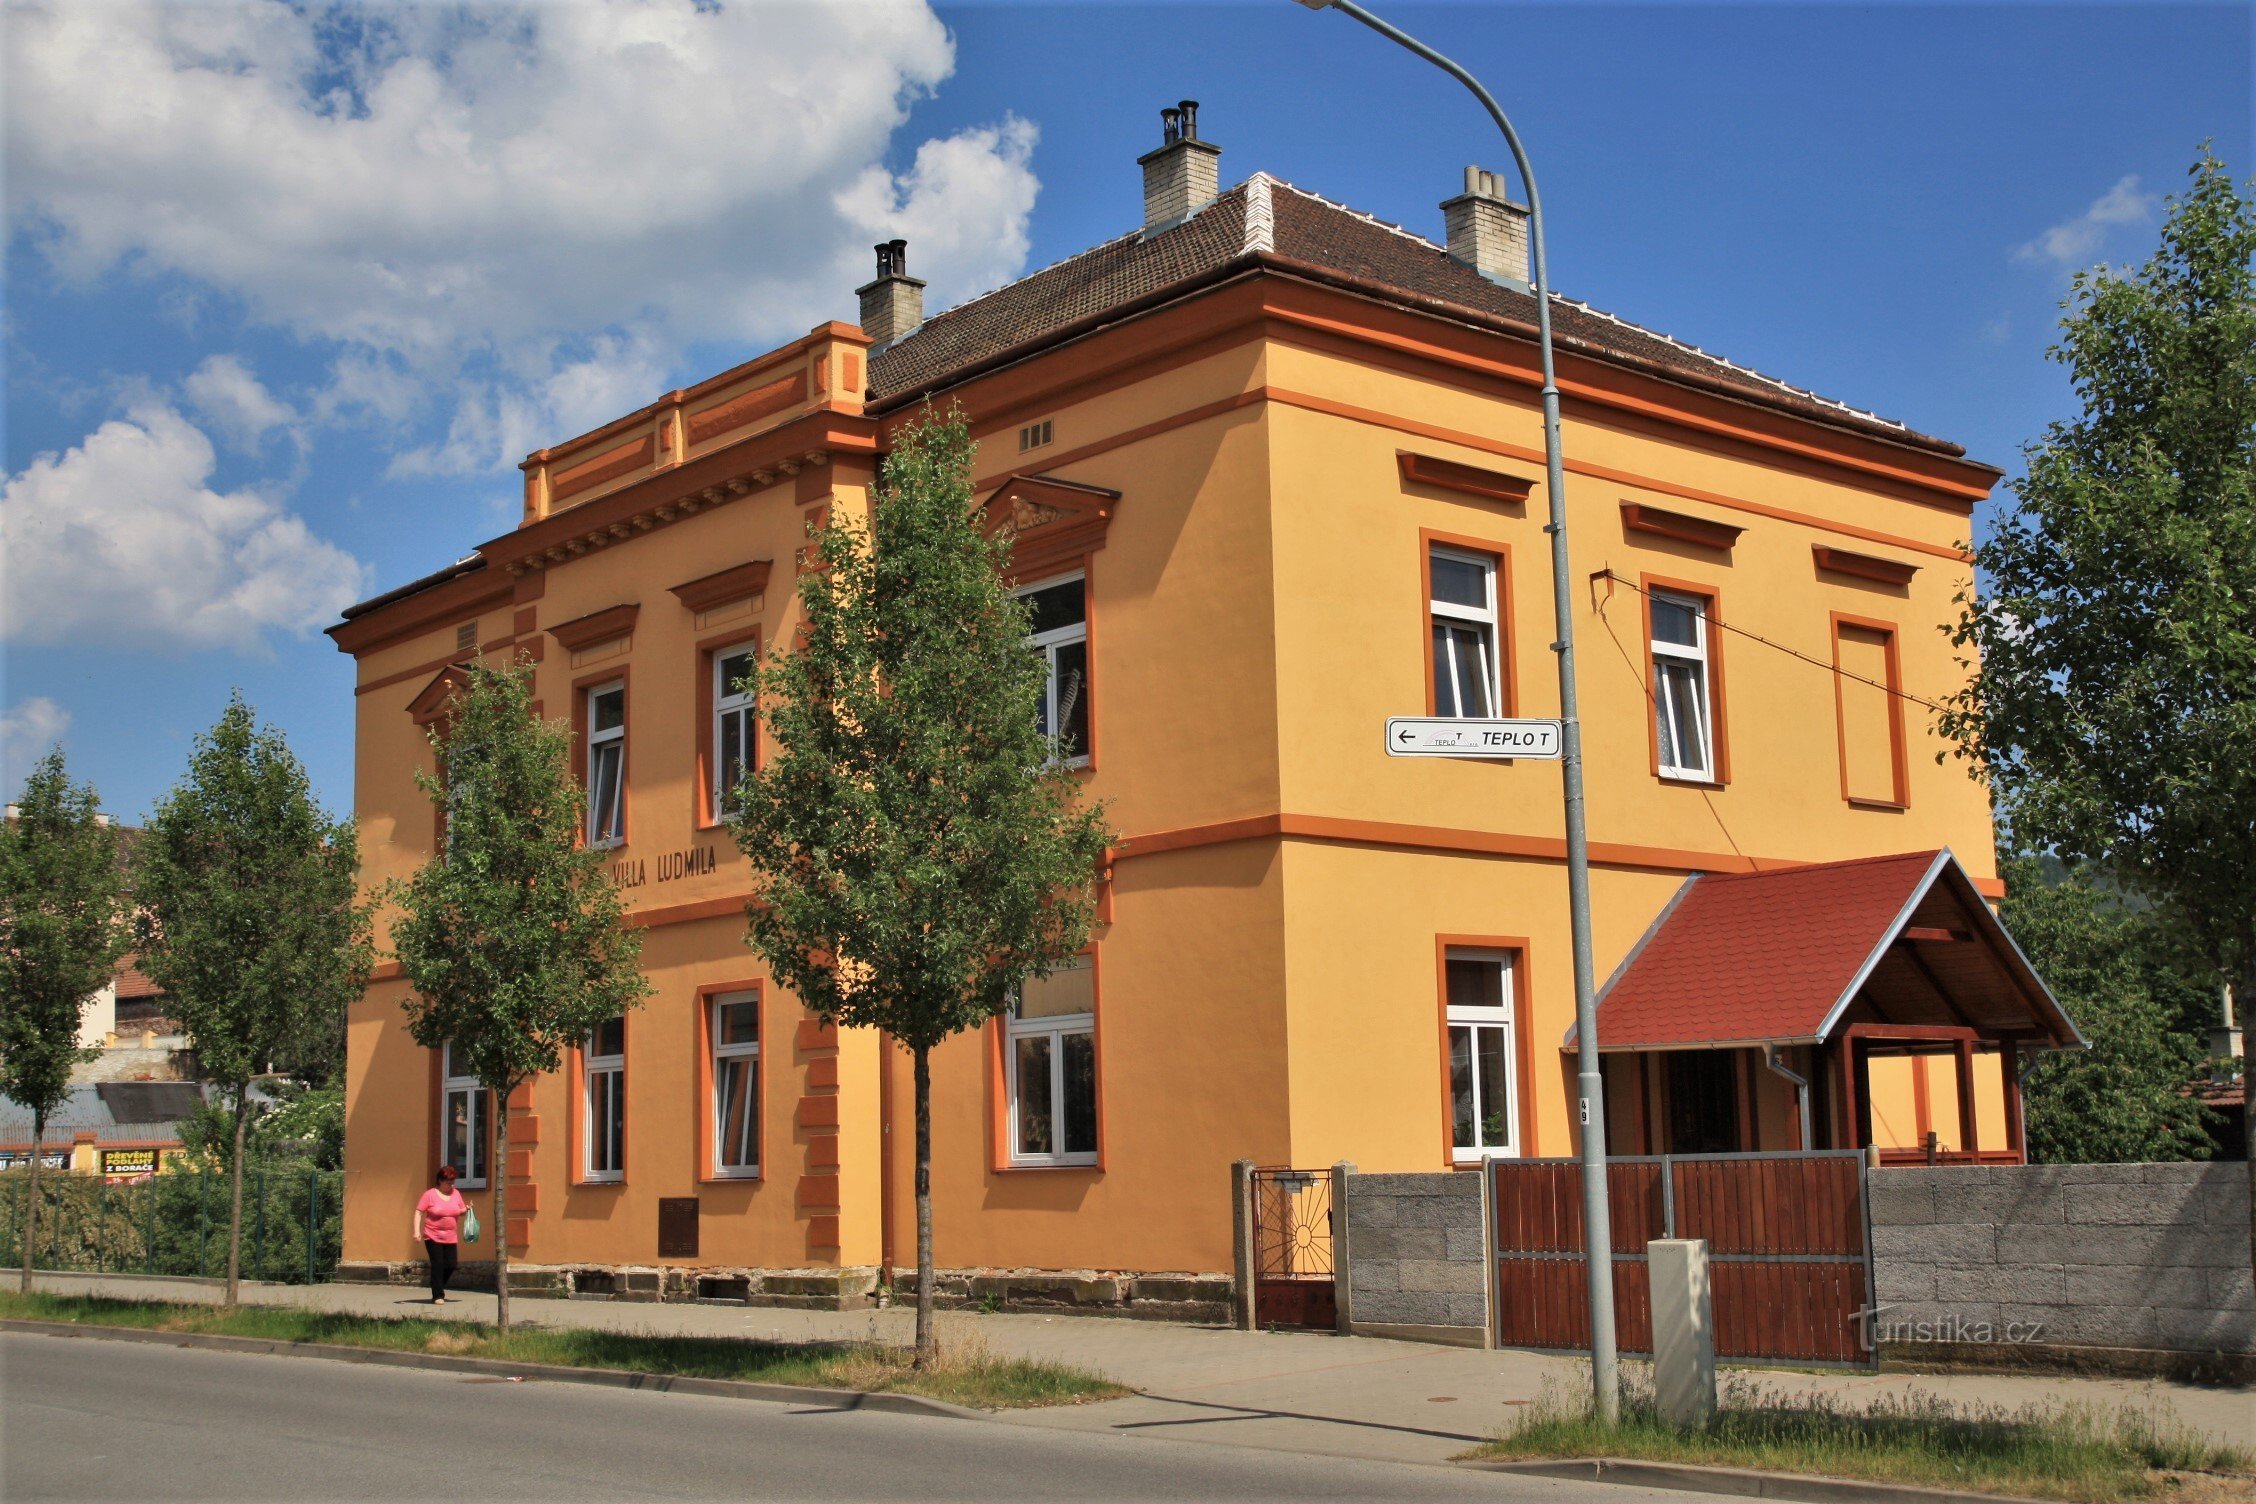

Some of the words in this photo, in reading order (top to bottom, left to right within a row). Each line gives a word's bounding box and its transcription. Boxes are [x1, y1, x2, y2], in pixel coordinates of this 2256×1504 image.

[1482, 732, 1535, 746] TEPLO
[1540, 732, 1550, 746] T
[613, 859, 646, 889] VILLA
[657, 845, 716, 883] LUDMILA
[106, 1151, 154, 1159] DŘEVĚNÉ
[115, 1163, 154, 1171] BORAČE
